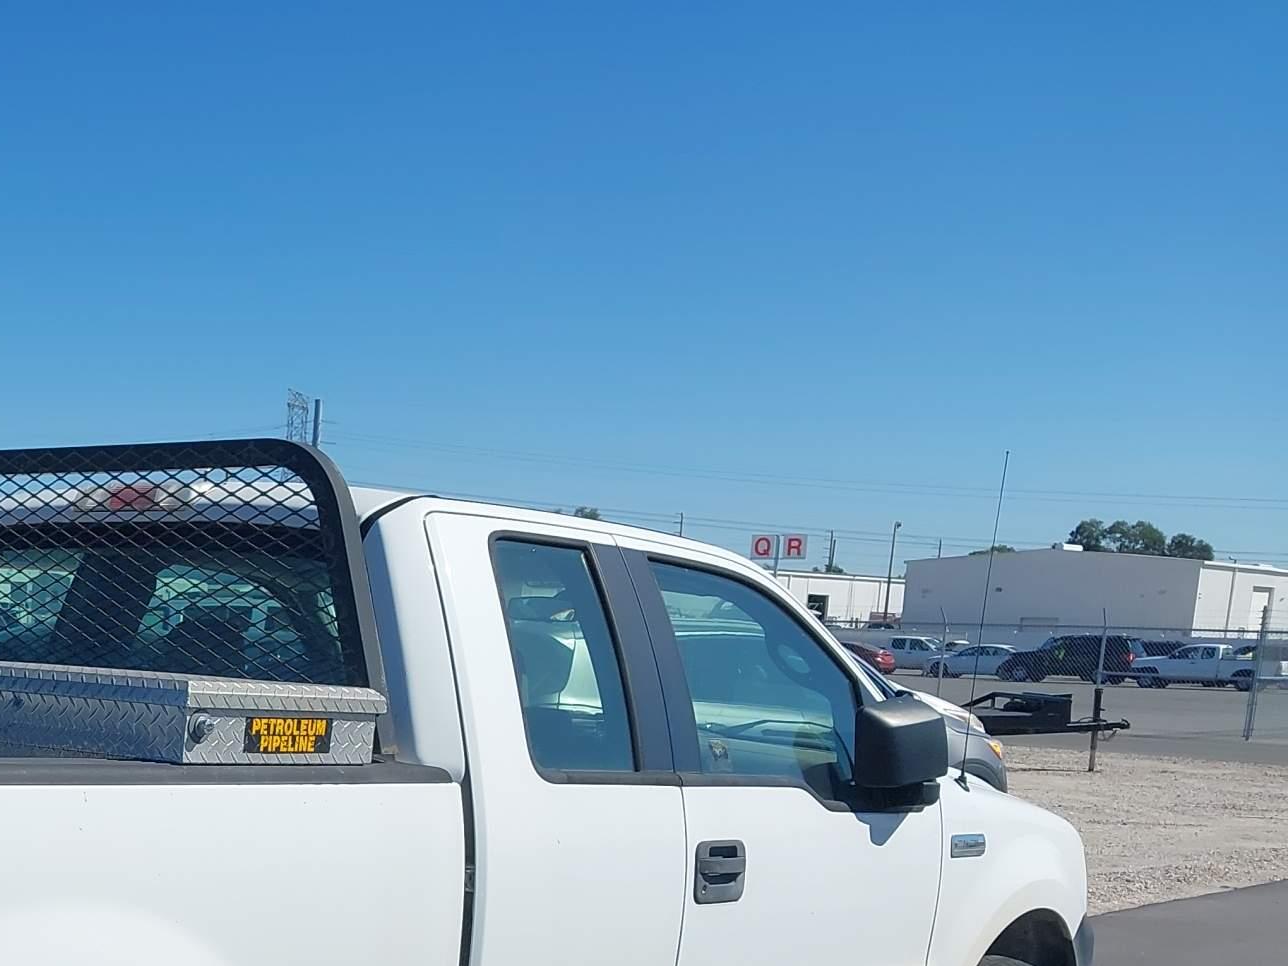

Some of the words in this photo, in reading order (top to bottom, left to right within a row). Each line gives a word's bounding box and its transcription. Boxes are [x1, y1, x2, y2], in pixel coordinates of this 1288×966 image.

[755, 537, 771, 556] Q
[787, 537, 802, 556] R
[252, 718, 327, 736] PETROLEUM
[259, 735, 316, 752] PIPELINE
